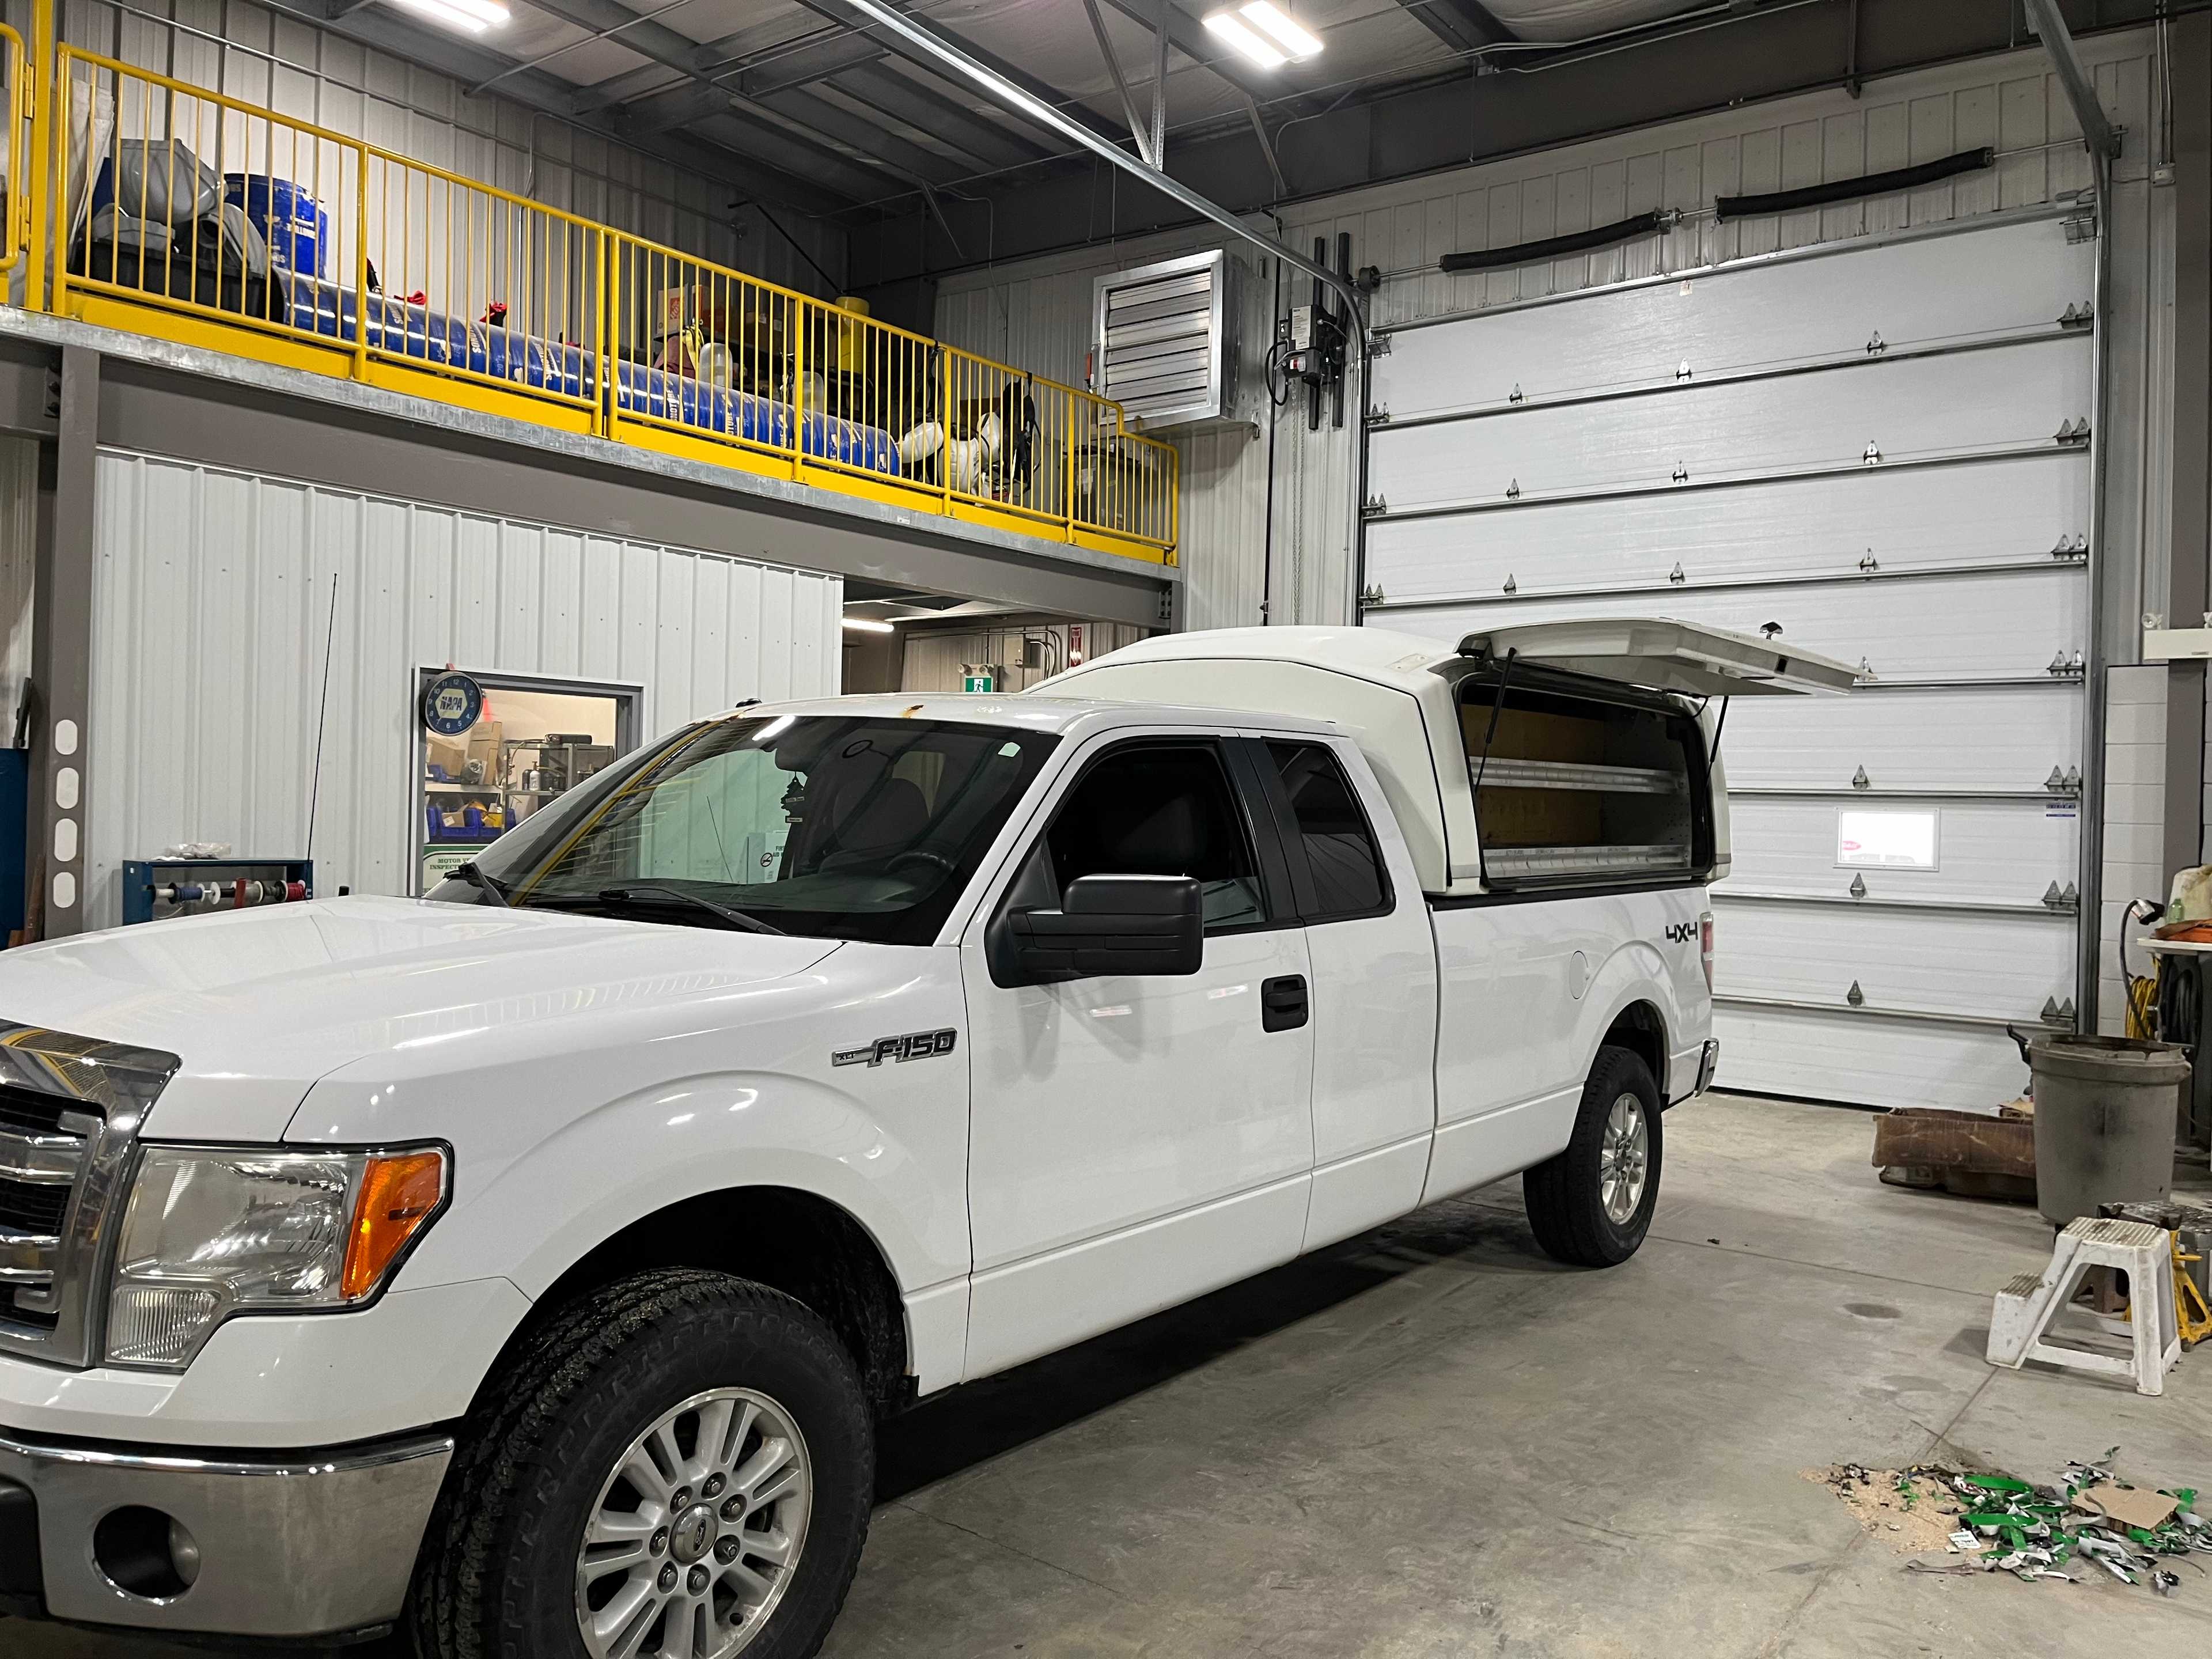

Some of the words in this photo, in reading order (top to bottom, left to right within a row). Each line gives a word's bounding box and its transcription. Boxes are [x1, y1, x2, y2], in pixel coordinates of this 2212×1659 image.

[440, 696, 463, 711] NAPA
[839, 1052, 855, 1061] XLT
[869, 1028, 957, 1067] F-150
